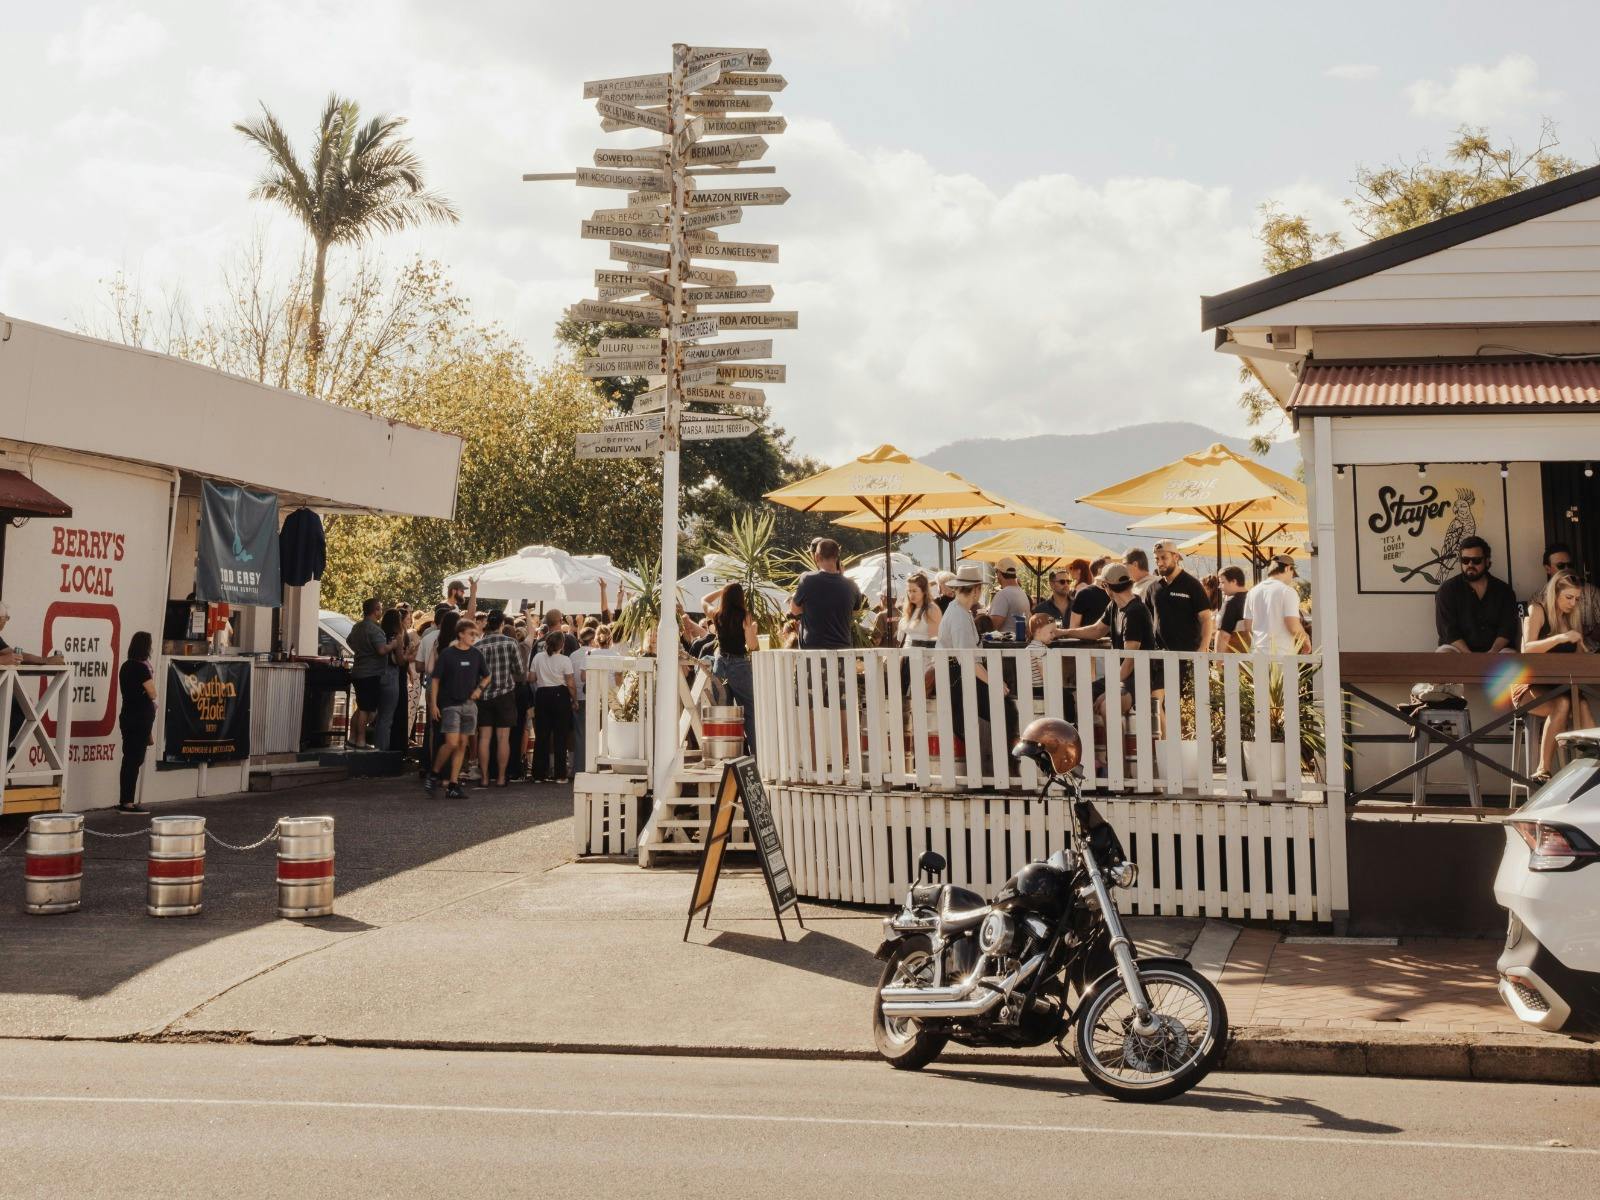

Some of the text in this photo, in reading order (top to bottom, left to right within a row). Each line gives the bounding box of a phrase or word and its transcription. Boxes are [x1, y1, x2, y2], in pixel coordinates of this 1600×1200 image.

[598, 80, 645, 90] BARCELONA
[722, 78, 758, 86] ANGELES
[707, 100, 751, 108] MONTREAL
[637, 112, 657, 126] PALACE
[708, 122, 737, 131] MEXICO
[739, 121, 756, 130] CITY
[691, 145, 731, 159] BERMUDA
[597, 154, 633, 162] SOWETO
[578, 173, 588, 181] MT
[591, 174, 634, 185] KOSCIUSKO
[691, 193, 731, 203] AMAZON
[734, 192, 759, 201] RIVER
[618, 213, 642, 221] BEACH
[685, 217, 702, 227] LORD
[702, 214, 720, 224] HOWE
[586, 225, 633, 237] THREDBO
[705, 246, 720, 255] LOS
[721, 247, 756, 257] ANGELES
[598, 273, 633, 284] PERTH
[688, 292, 703, 301] RIO
[704, 291, 713, 300] DE
[714, 290, 748, 299] JANEIRO
[739, 316, 769, 325] ATOLL
[602, 343, 634, 353] ULURU
[685, 347, 740, 359] GRAND CANYON
[595, 362, 616, 372] SILOS
[738, 369, 764, 379] LOUIS
[686, 388, 725, 399] BRISBANE
[614, 421, 645, 432] ATHENS
[705, 425, 724, 434] MALTA
[624, 445, 641, 453] VAN
[1368, 485, 1451, 537] Stayer
[51, 526, 125, 561] BERRY'S
[1383, 542, 1405, 552] LOVELY
[60, 563, 113, 597] LOCAL
[236, 571, 261, 585] EASY
[64, 637, 100, 652] GREAT
[197, 697, 225, 720] Hotel
[81, 743, 116, 761] BERRY
